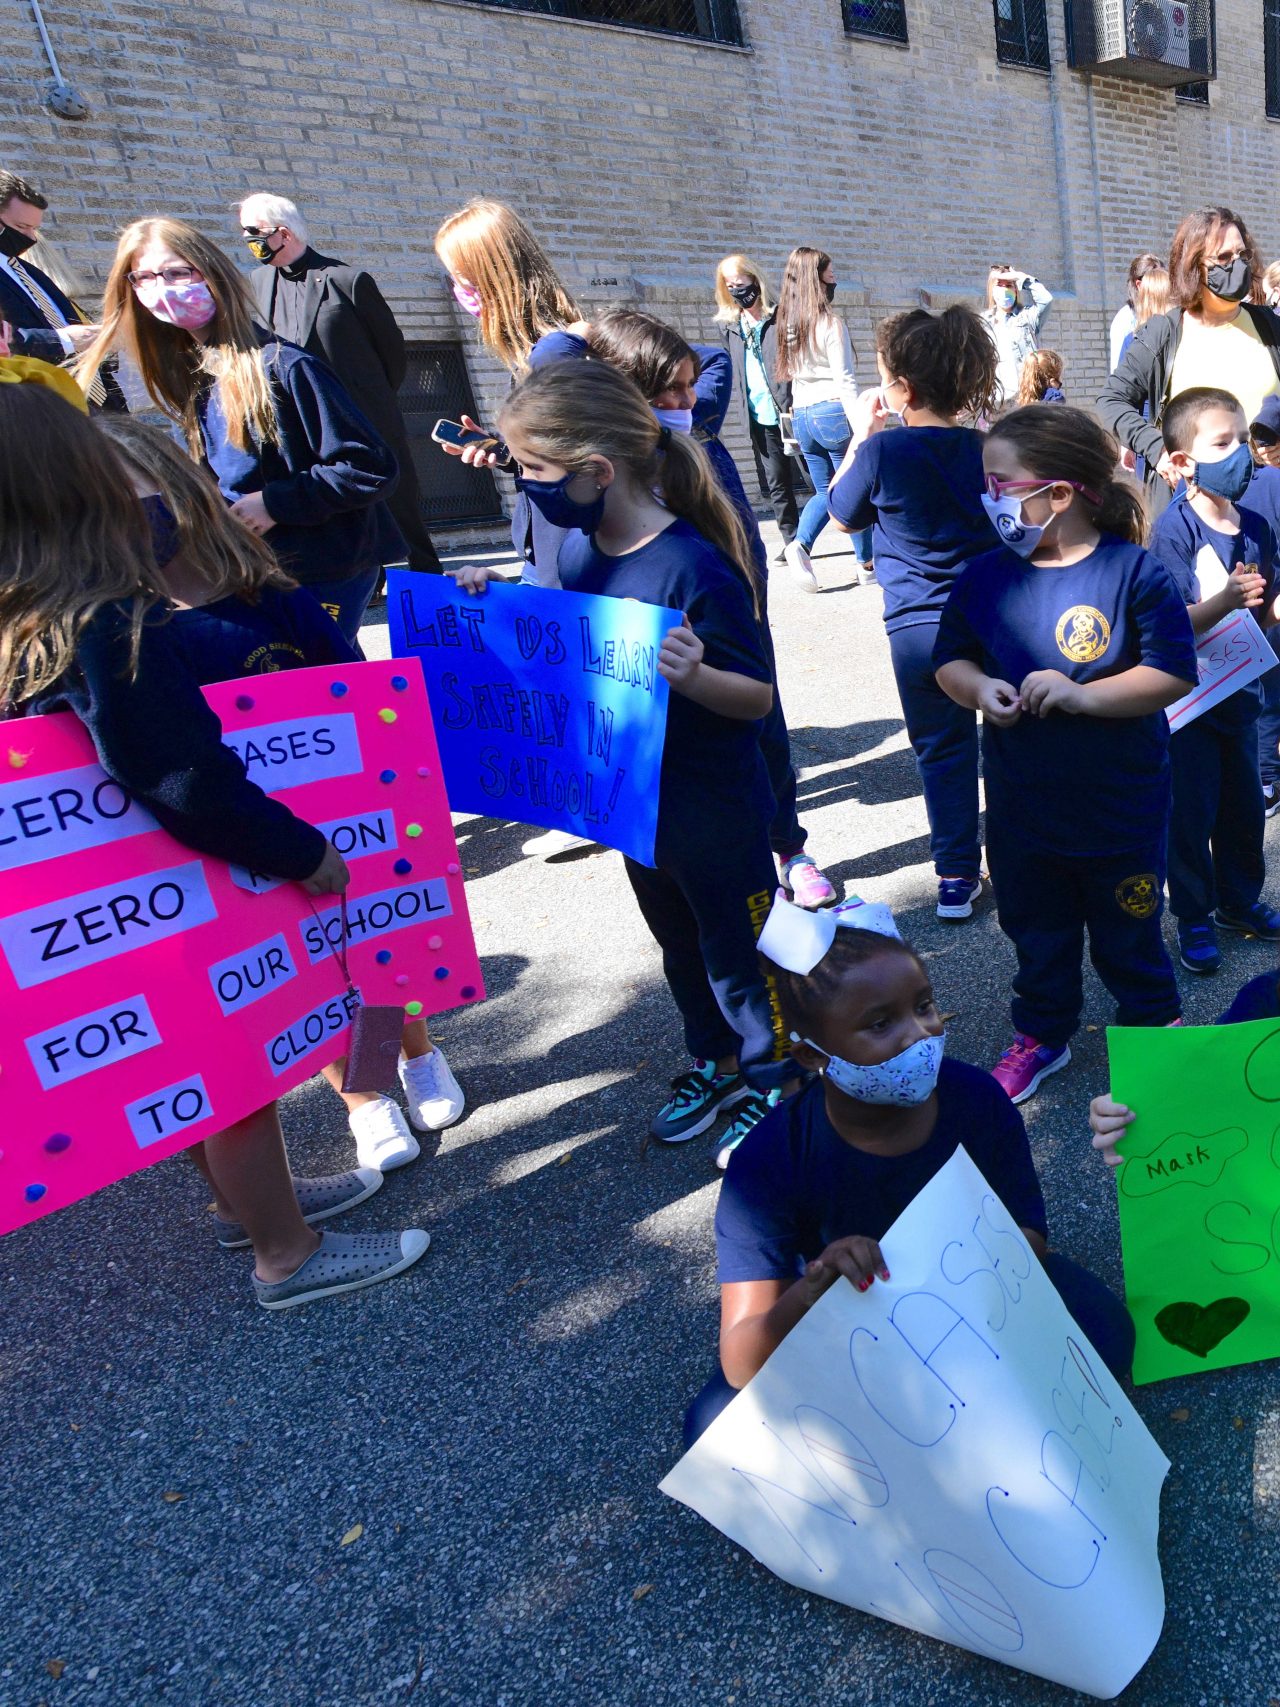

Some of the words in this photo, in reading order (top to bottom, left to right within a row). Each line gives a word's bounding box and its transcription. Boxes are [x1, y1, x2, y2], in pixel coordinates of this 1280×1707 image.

[400, 589, 485, 653] LET
[515, 615, 566, 665] US
[579, 615, 655, 696] LEARN
[229, 728, 336, 771] ASES
[441, 671, 570, 748] SAFELY
[587, 700, 614, 767] IN
[479, 746, 626, 825] SCHOOL!
[30, 881, 184, 962] ZERO
[43, 1009, 148, 1074] FOR
[216, 947, 290, 1003] OUR
[305, 891, 446, 955] SCHOOL
[138, 1087, 203, 1134] TO
[1146, 1144, 1211, 1180] Mask
[849, 1193, 1031, 1449] CASES
